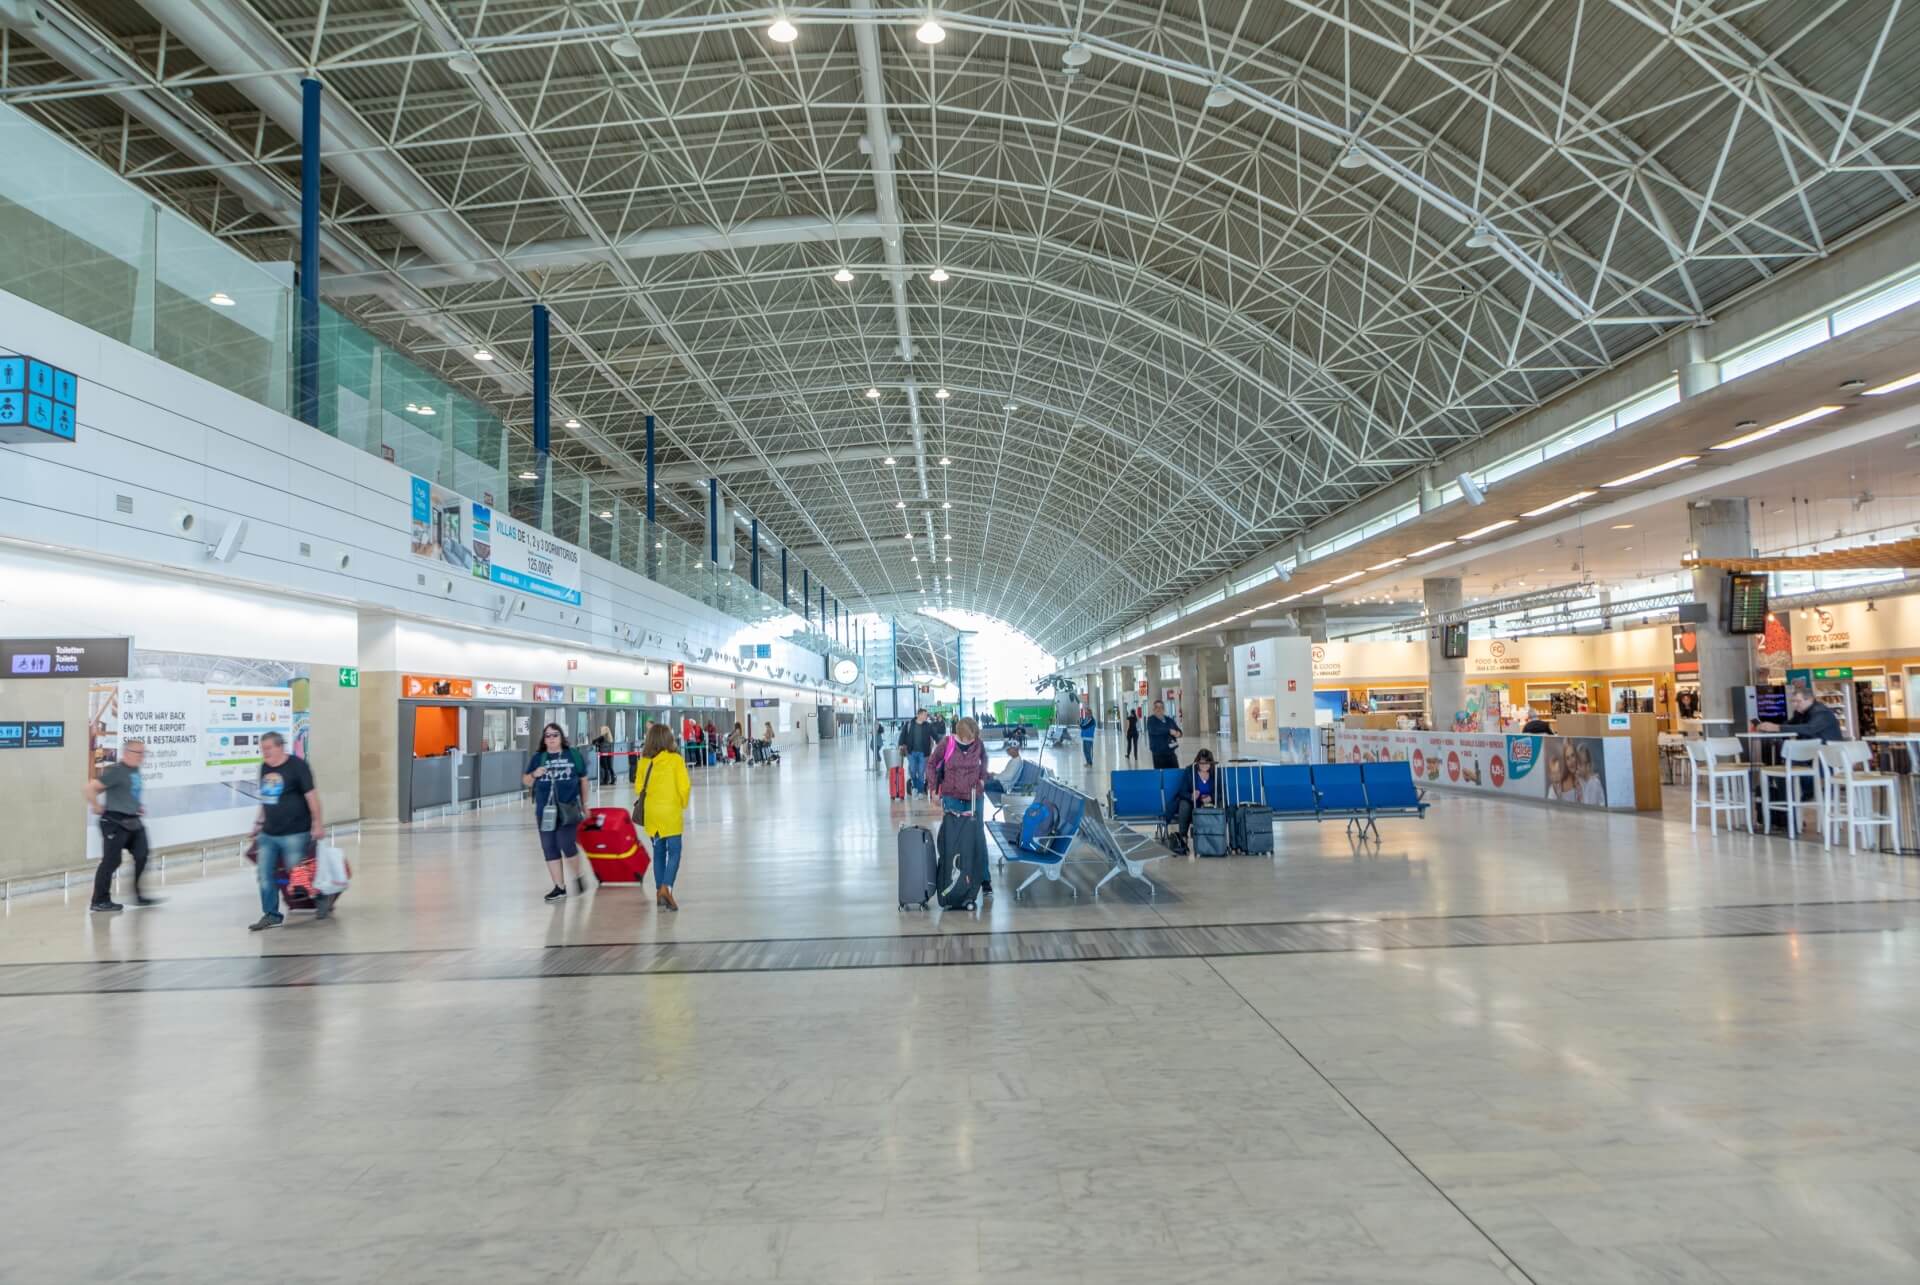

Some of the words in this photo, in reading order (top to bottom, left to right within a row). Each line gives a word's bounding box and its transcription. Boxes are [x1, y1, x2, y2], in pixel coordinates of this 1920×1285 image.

[496, 520, 517, 540] VILLAS
[517, 528, 526, 543] DE
[1673, 633, 1684, 654] I
[55, 655, 78, 663] Toilets
[54, 664, 79, 672] Aseos
[123, 711, 133, 721] ON
[135, 711, 153, 721] YOUR
[154, 711, 169, 720] WAY
[170, 711, 186, 720] BACK
[123, 724, 143, 734] ENJOY
[145, 724, 158, 733] THE
[159, 723, 186, 732] AIRPORT
[147, 735, 152, 744] &
[153, 734, 197, 744] RESTAURANTS
